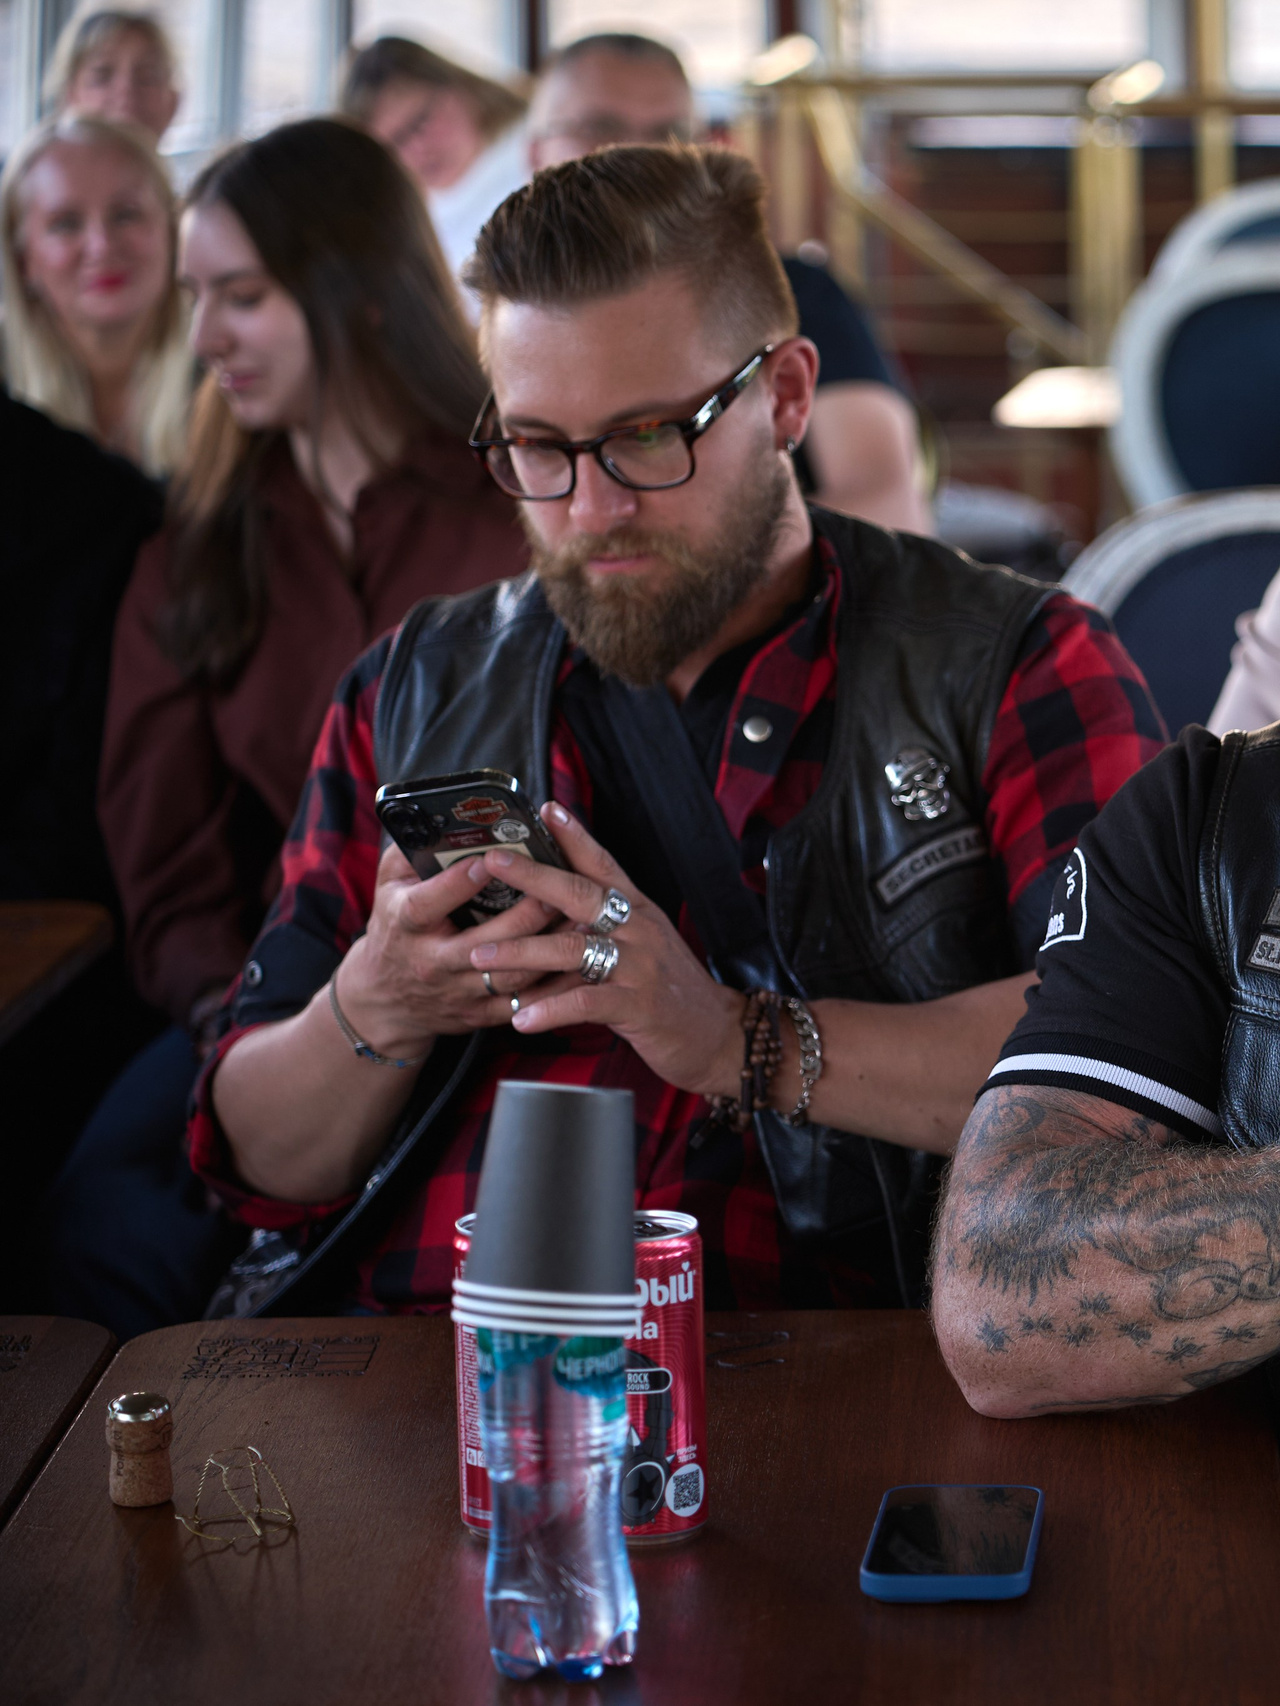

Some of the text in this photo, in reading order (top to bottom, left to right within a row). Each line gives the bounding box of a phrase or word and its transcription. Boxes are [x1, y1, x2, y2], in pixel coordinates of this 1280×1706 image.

[886, 835, 982, 895] SECRETA
[627, 1373, 649, 1384] ROCK
[626, 1383, 650, 1391] SOUND
